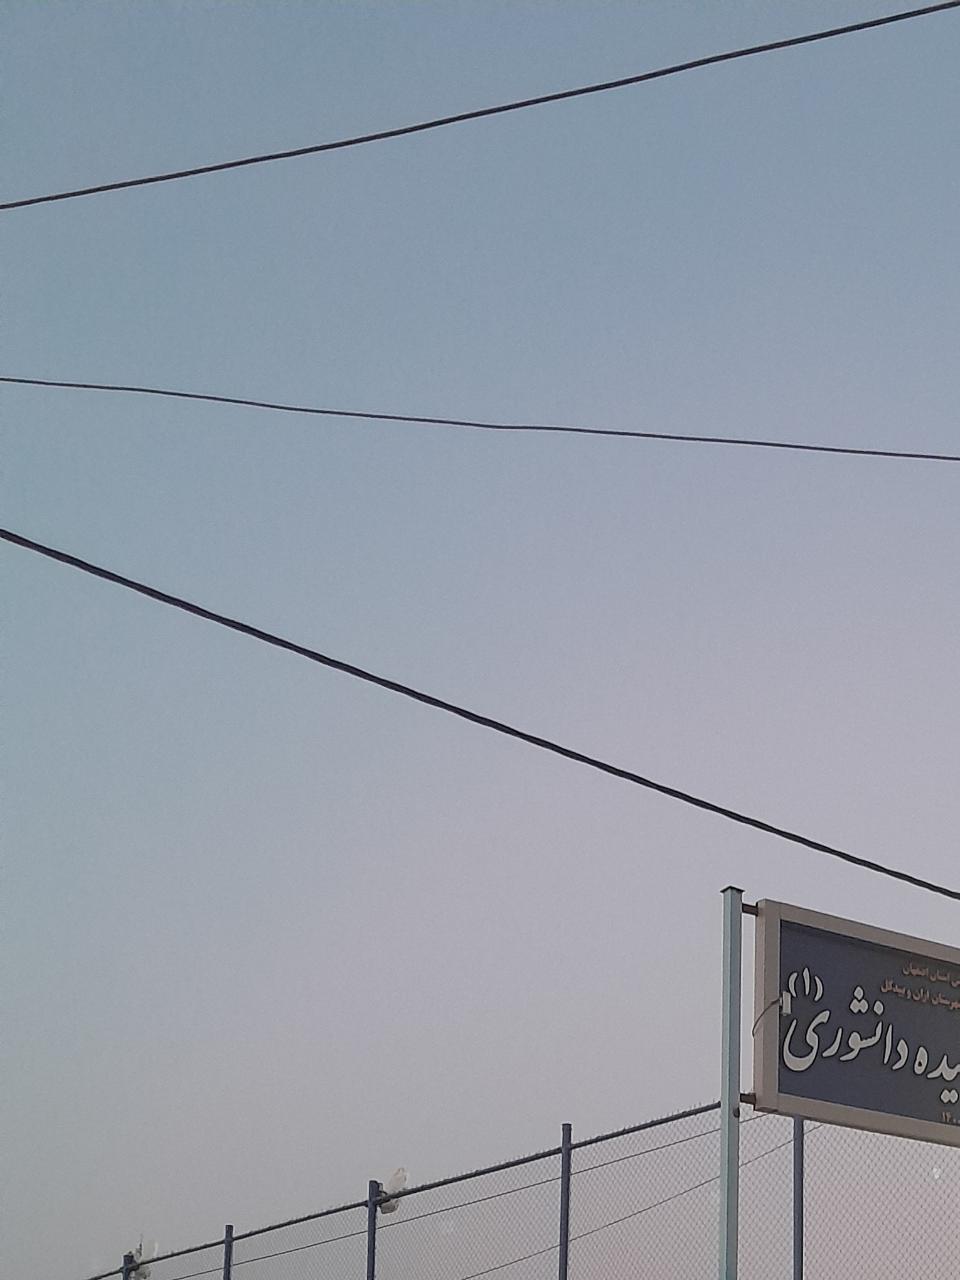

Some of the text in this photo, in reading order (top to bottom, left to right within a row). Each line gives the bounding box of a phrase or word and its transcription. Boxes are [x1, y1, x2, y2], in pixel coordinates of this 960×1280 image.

[902, 962, 929, 977] اصفهان
[929, 968, 951, 982] استان
[782, 985, 910, 1072] دانشوری
